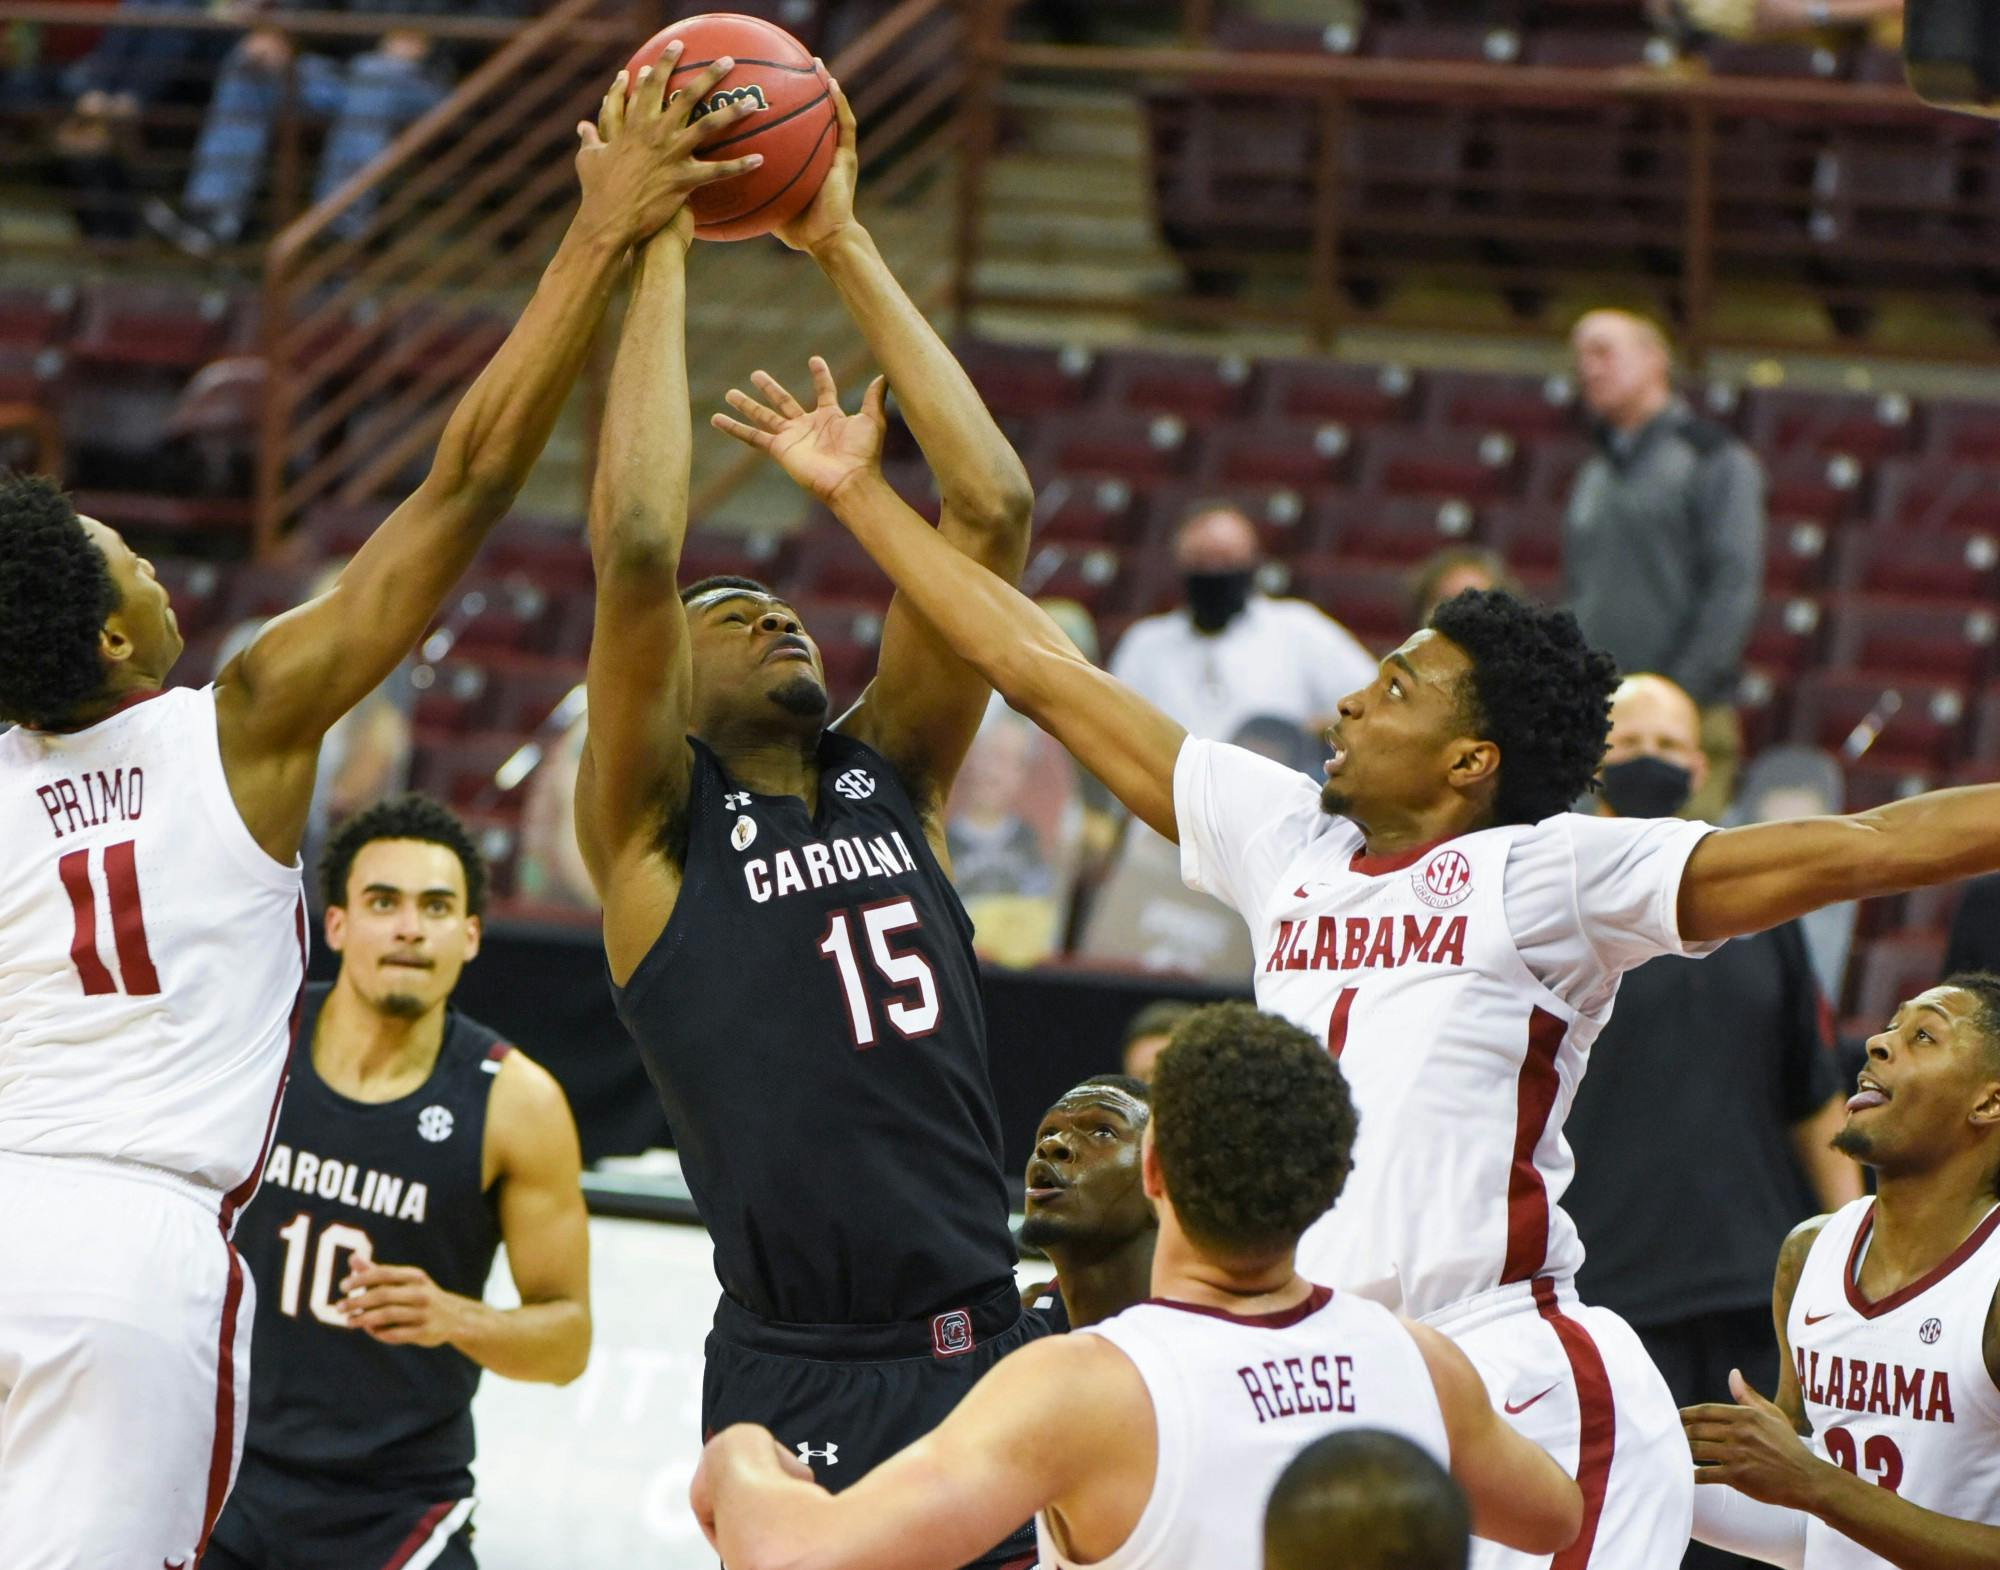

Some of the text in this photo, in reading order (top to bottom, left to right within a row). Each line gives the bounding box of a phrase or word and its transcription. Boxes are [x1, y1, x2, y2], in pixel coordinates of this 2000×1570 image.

[36, 767, 143, 838] PRIMO
[834, 768, 876, 800] SEC
[743, 831, 917, 903] CAROLNA
[1426, 850, 1470, 896] SEC
[59, 840, 161, 996] 11
[1266, 915, 1468, 972] ALABAMA
[816, 897, 941, 1051] 15
[264, 1143, 428, 1223] AROLINA
[280, 1213, 373, 1330] 10
[1237, 1355, 1356, 1423] REESE
[1797, 1346, 1954, 1423] ALABAMA
